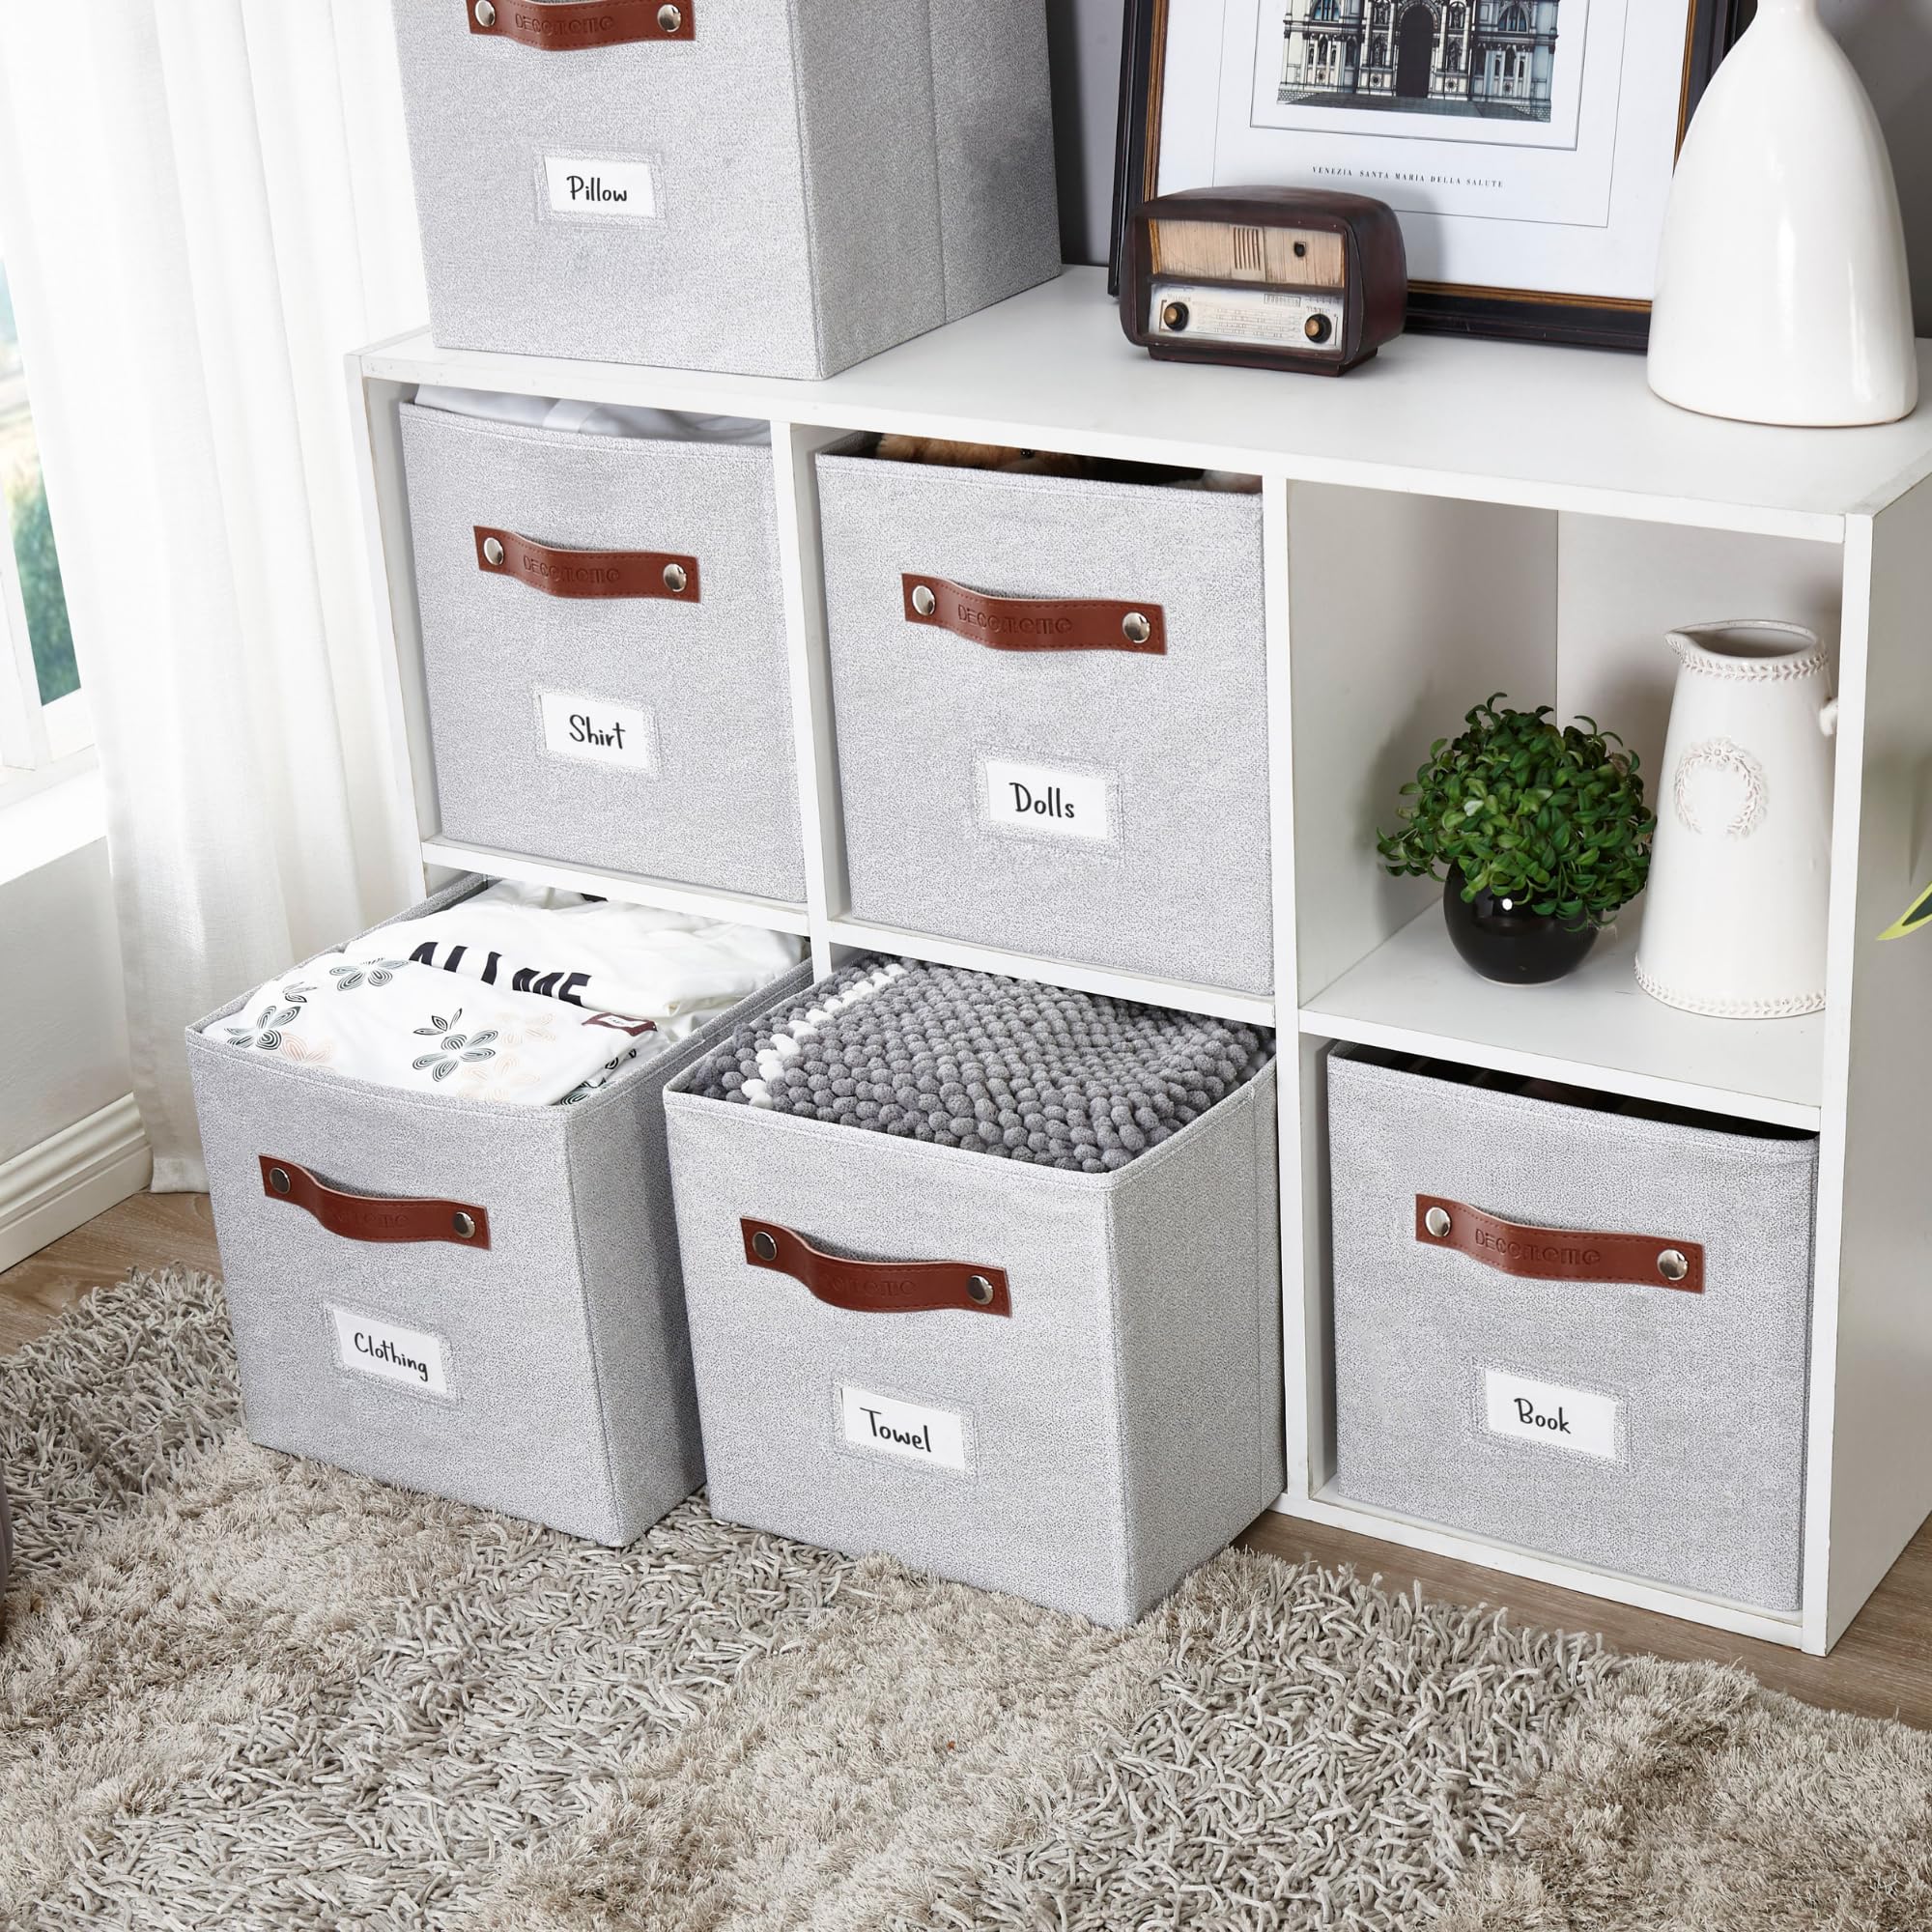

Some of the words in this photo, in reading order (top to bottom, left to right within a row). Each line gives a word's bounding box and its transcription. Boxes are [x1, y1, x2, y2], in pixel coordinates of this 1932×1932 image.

[566, 175, 628, 202] Pillow
[1312, 166, 1352, 177] VENEZIA
[1359, 169, 1389, 180] SANTA
[1395, 172, 1425, 183] MARIA
[1430, 175, 1461, 185] DELLA
[1465, 178, 1504, 188] SALUTE
[569, 714, 626, 750] Shirt
[1009, 782, 1075, 818] Dolls
[354, 1332, 429, 1382] Clothing
[859, 1406, 932, 1453] Towel
[1514, 1398, 1572, 1435] Book
